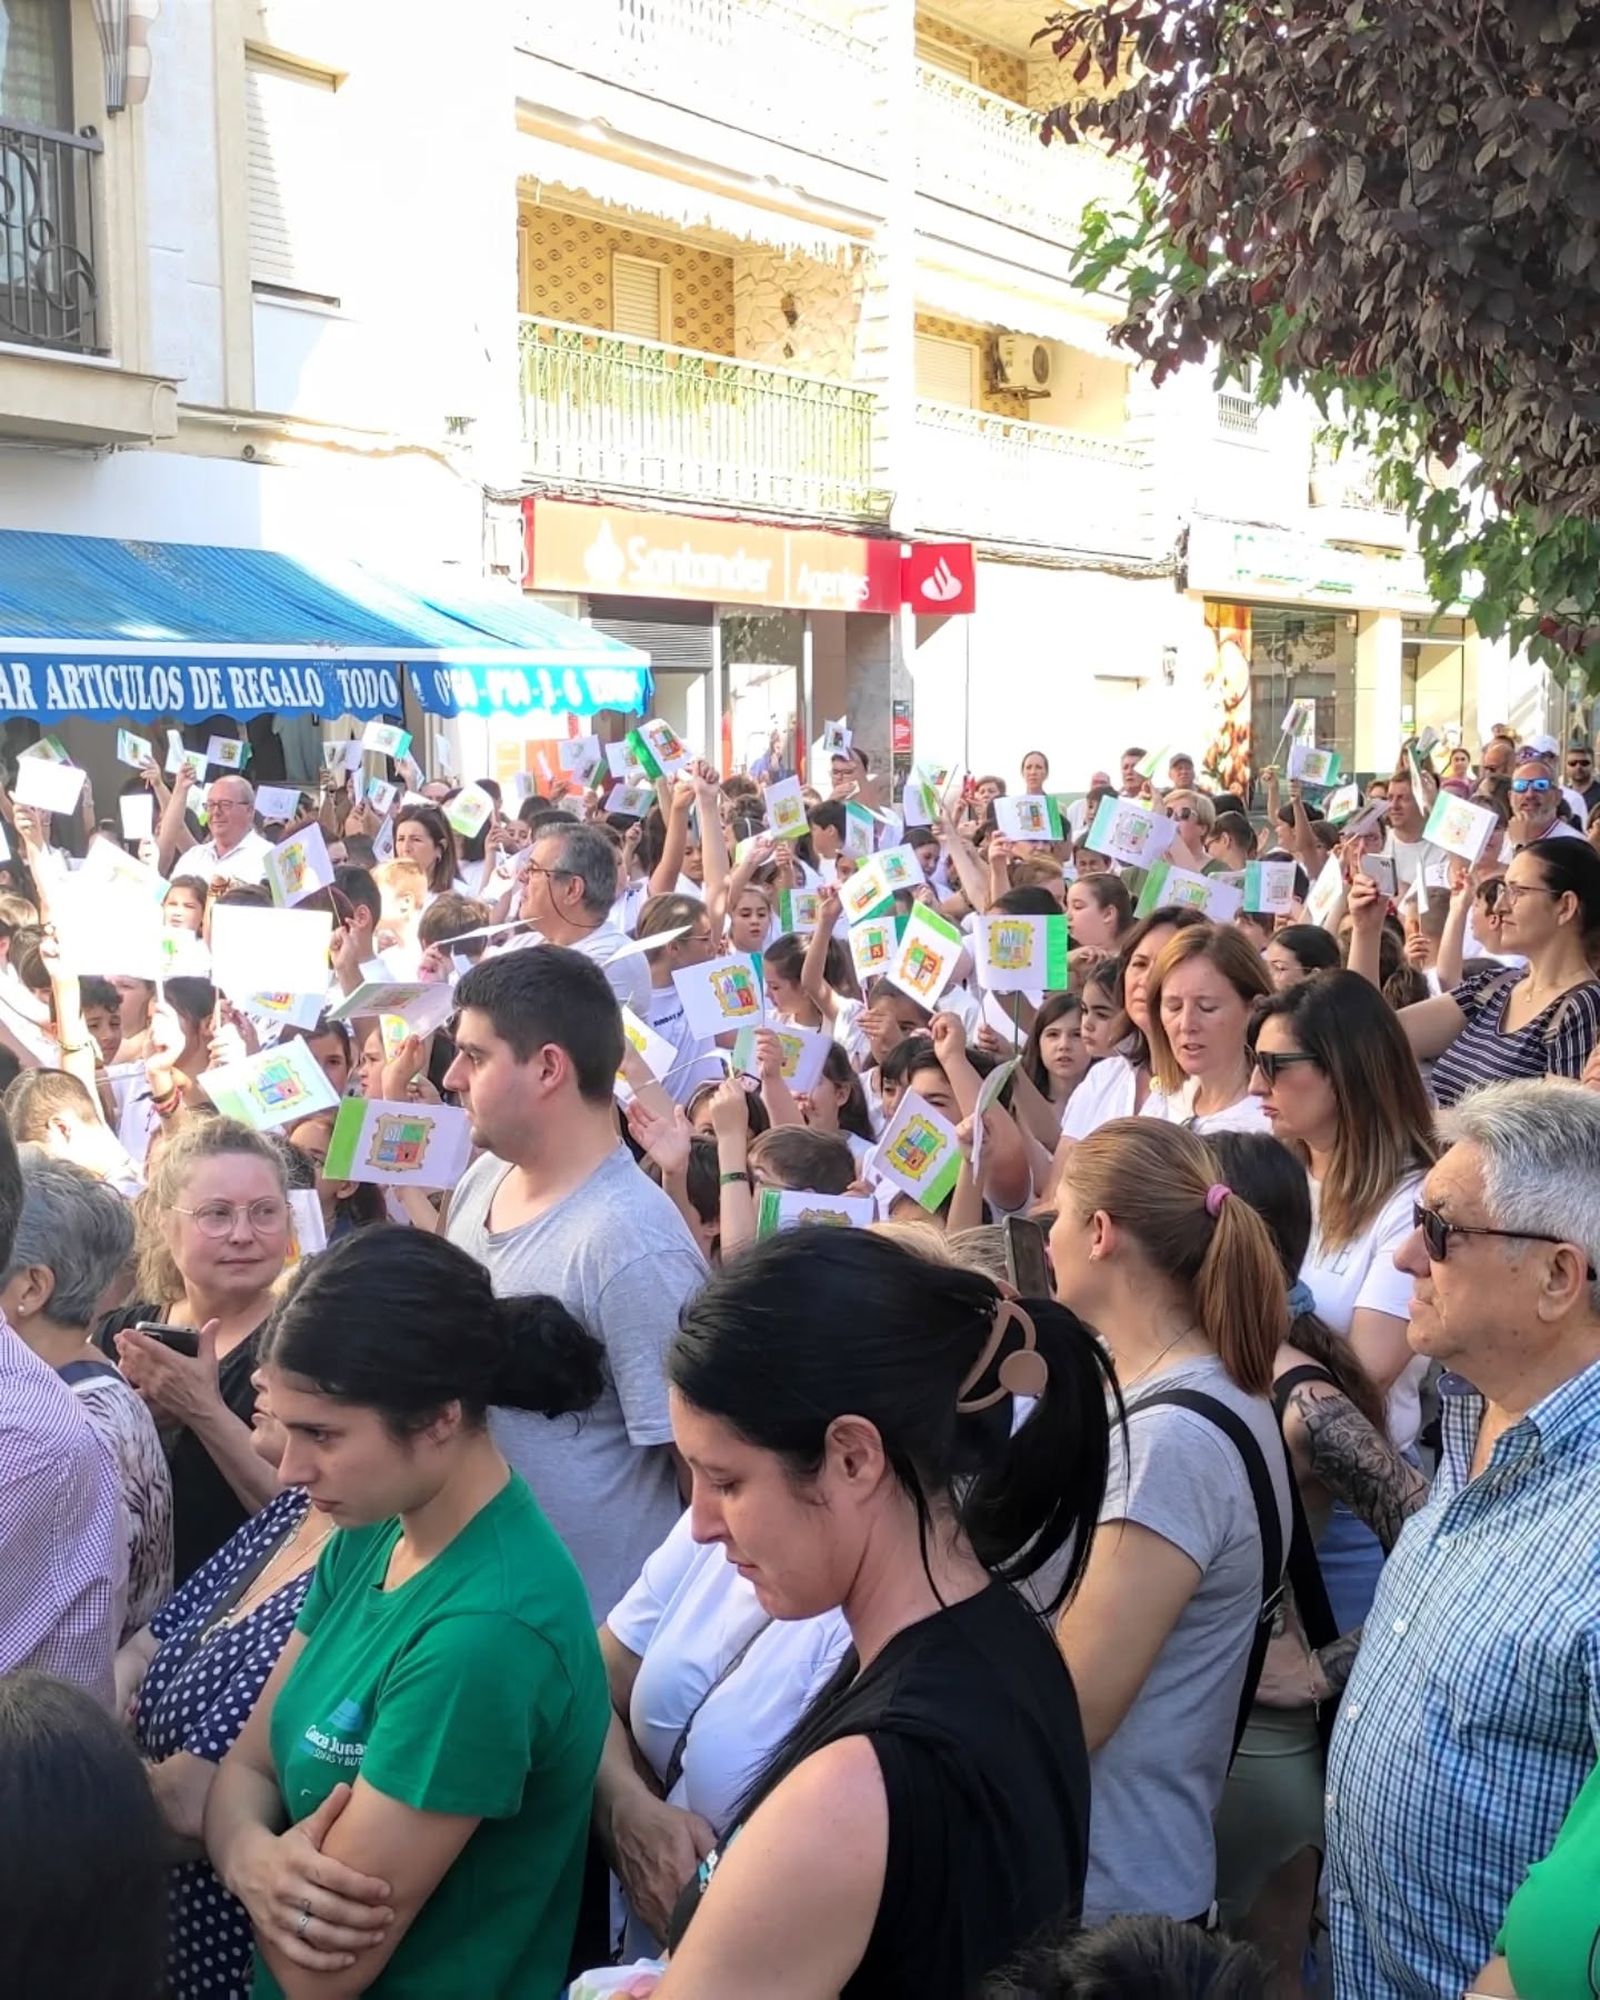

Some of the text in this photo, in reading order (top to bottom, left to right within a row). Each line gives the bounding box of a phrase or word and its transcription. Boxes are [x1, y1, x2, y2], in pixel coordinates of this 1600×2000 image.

[46, 663, 185, 711] ARTICULOS
[188, 665, 227, 710] DE
[227, 666, 325, 709] REGALO
[337, 668, 399, 709] TODO
